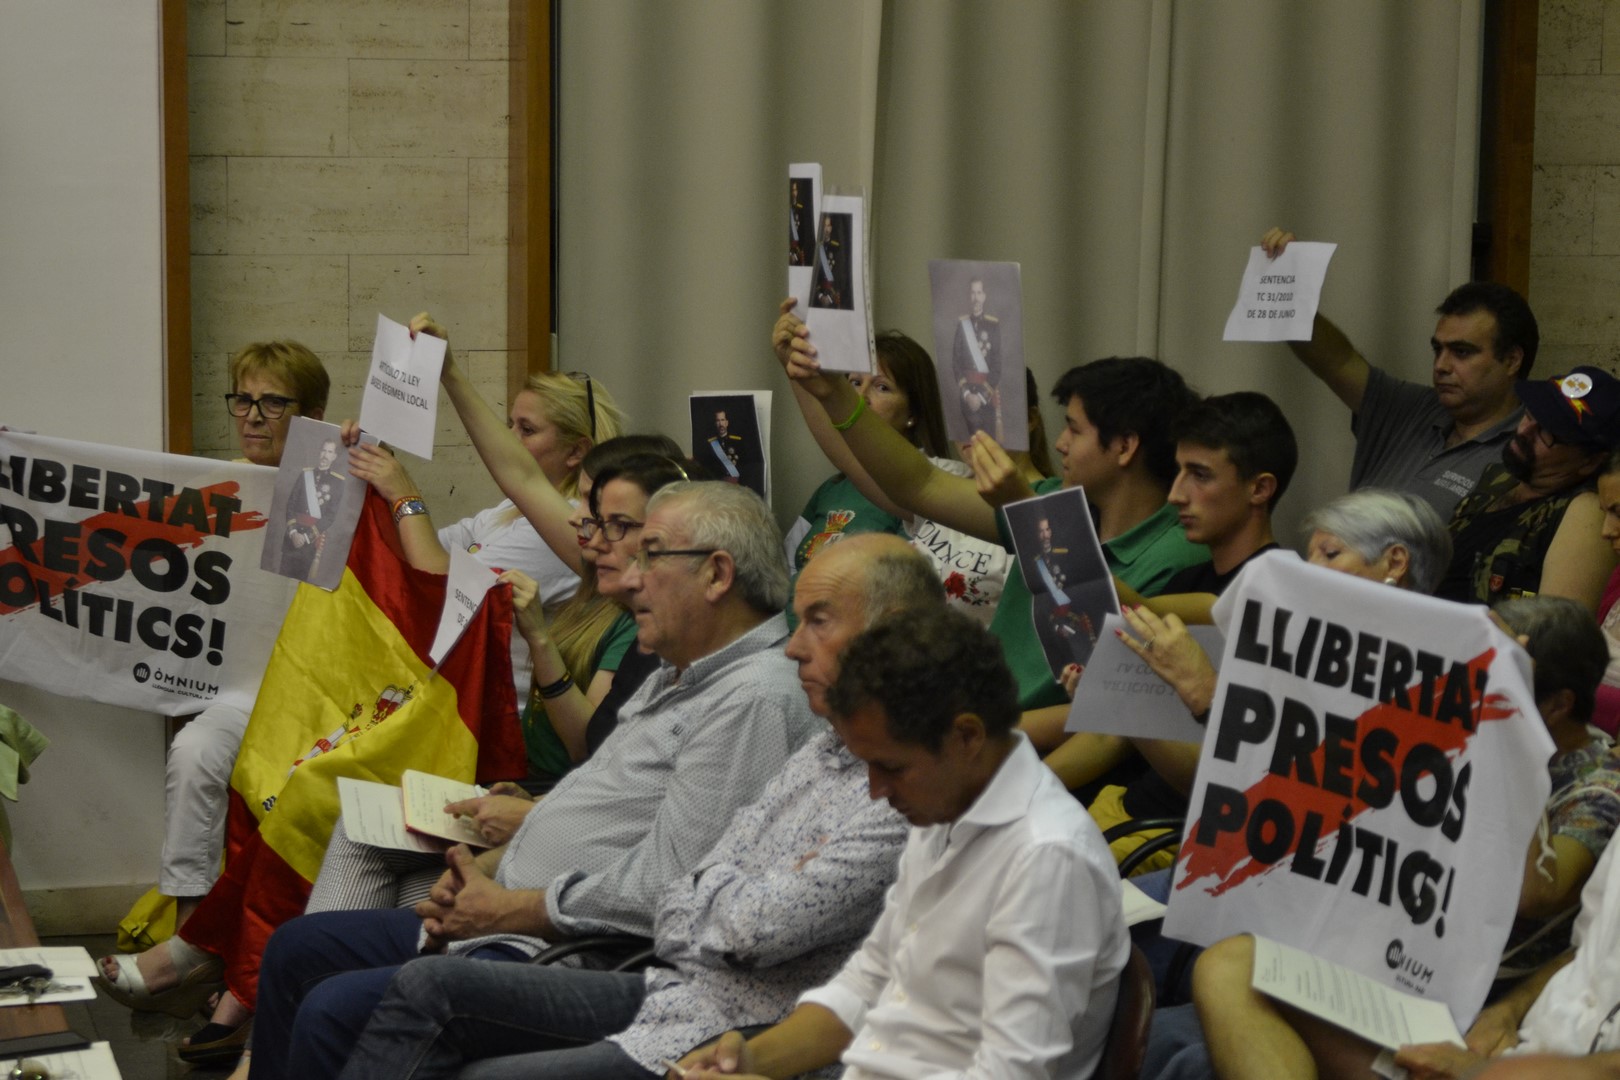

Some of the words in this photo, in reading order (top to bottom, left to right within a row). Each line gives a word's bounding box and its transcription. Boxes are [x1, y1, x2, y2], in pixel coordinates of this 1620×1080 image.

[1259, 275, 1296, 284] SENTENCIA
[1257, 292, 1266, 301] TC
[1247, 309, 1256, 319] DE
[1257, 309, 1267, 319] 28
[1268, 309, 1278, 319] DE
[408, 374, 421, 388] LEY
[406, 392, 429, 410] LOCAL
[455, 588, 478, 613] SENTENC
[1213, 683, 1472, 843] PRESOS
